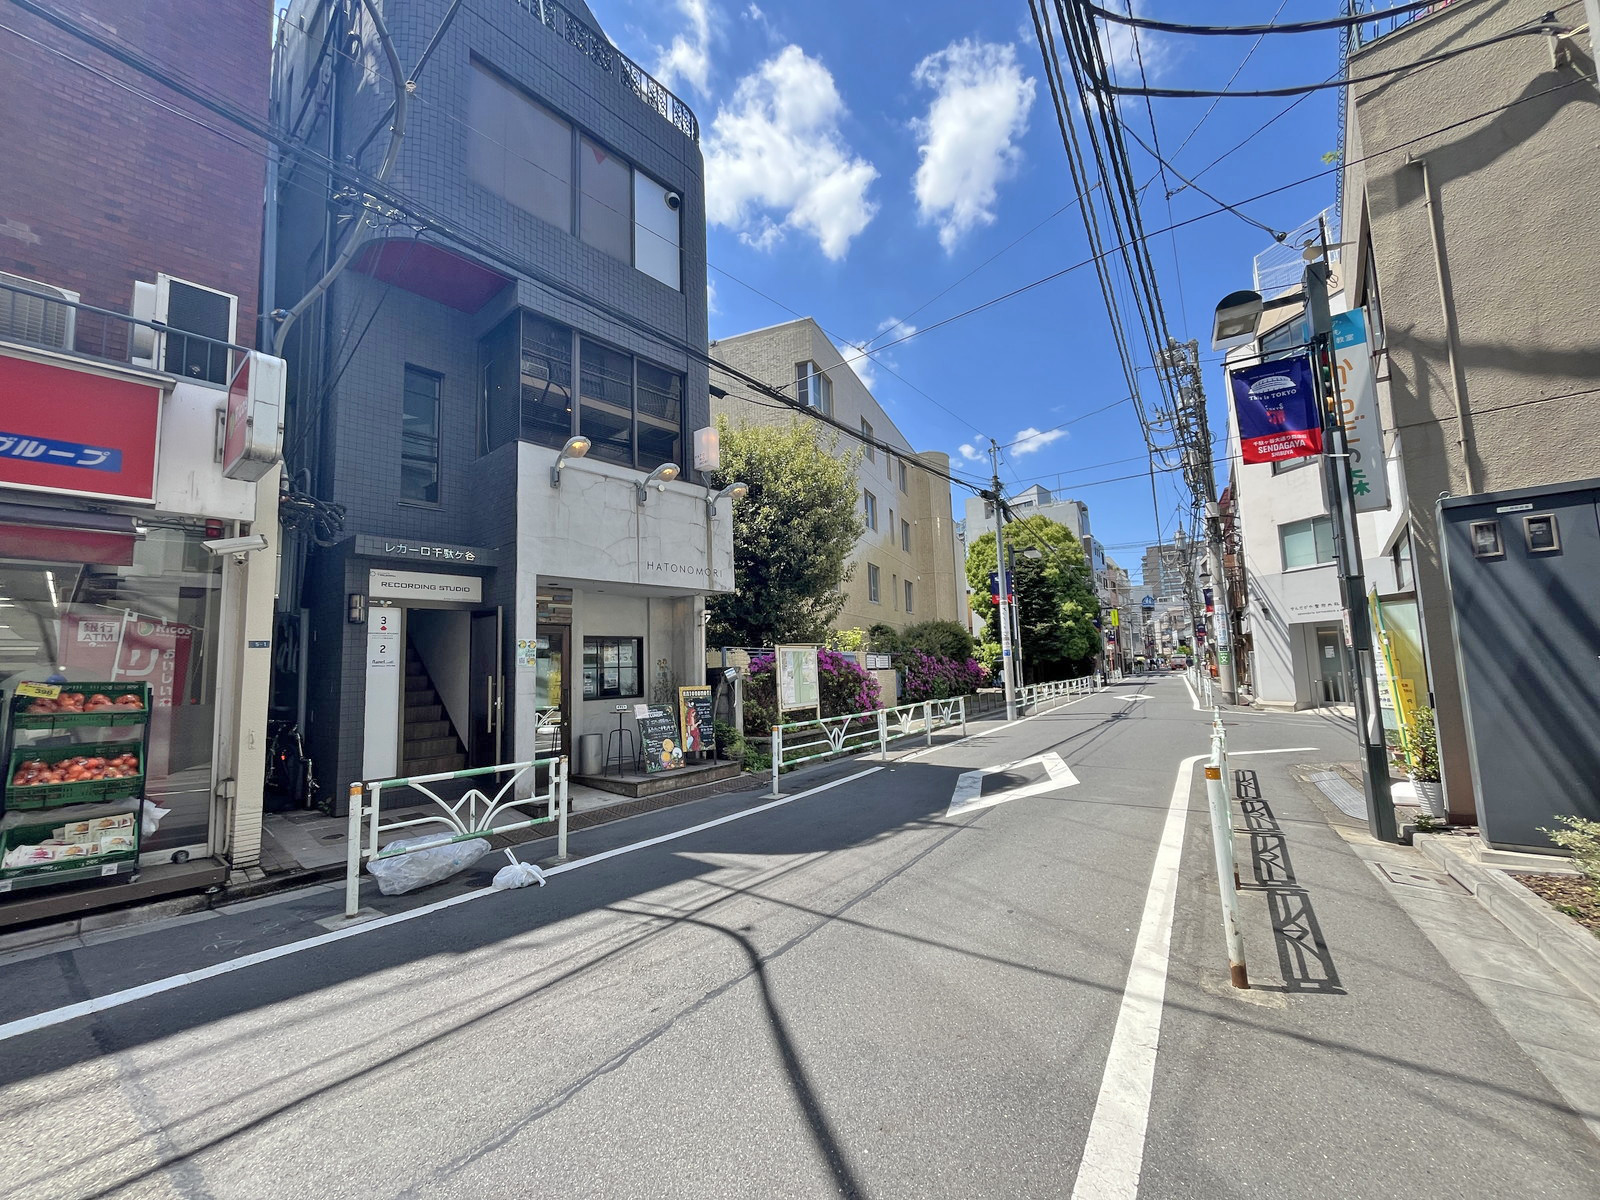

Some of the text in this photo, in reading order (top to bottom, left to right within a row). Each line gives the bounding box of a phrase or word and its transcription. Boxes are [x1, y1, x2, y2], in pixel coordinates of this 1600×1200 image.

[1271, 389, 1297, 399] TOKYO
[1258, 439, 1306, 454] SENDAGAYA
[1271, 449, 1294, 458] SHIBUYA
[646, 561, 723, 578] HATONOMORI
[381, 581, 471, 593] RECORDING STUDIO
[380, 616, 387, 625] 3
[83, 622, 115, 633] 銀行
[379, 644, 386, 654] 2
